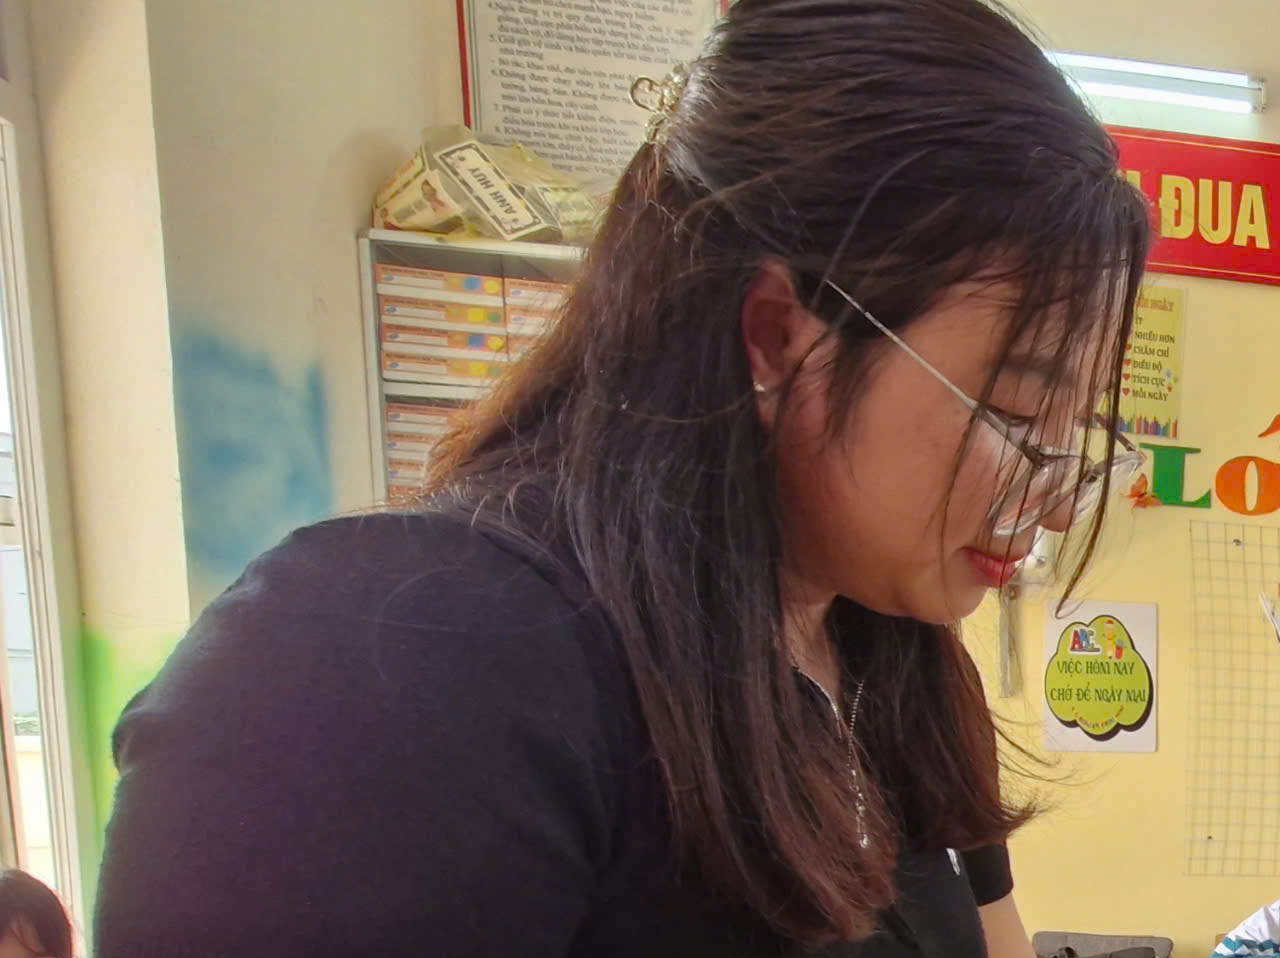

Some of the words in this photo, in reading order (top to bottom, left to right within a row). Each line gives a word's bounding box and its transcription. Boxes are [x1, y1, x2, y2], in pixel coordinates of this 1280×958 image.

[1158, 173, 1270, 250] ĐUA
[1113, 662, 1135, 675] NAY
[1094, 685, 1123, 703] NGÀY
